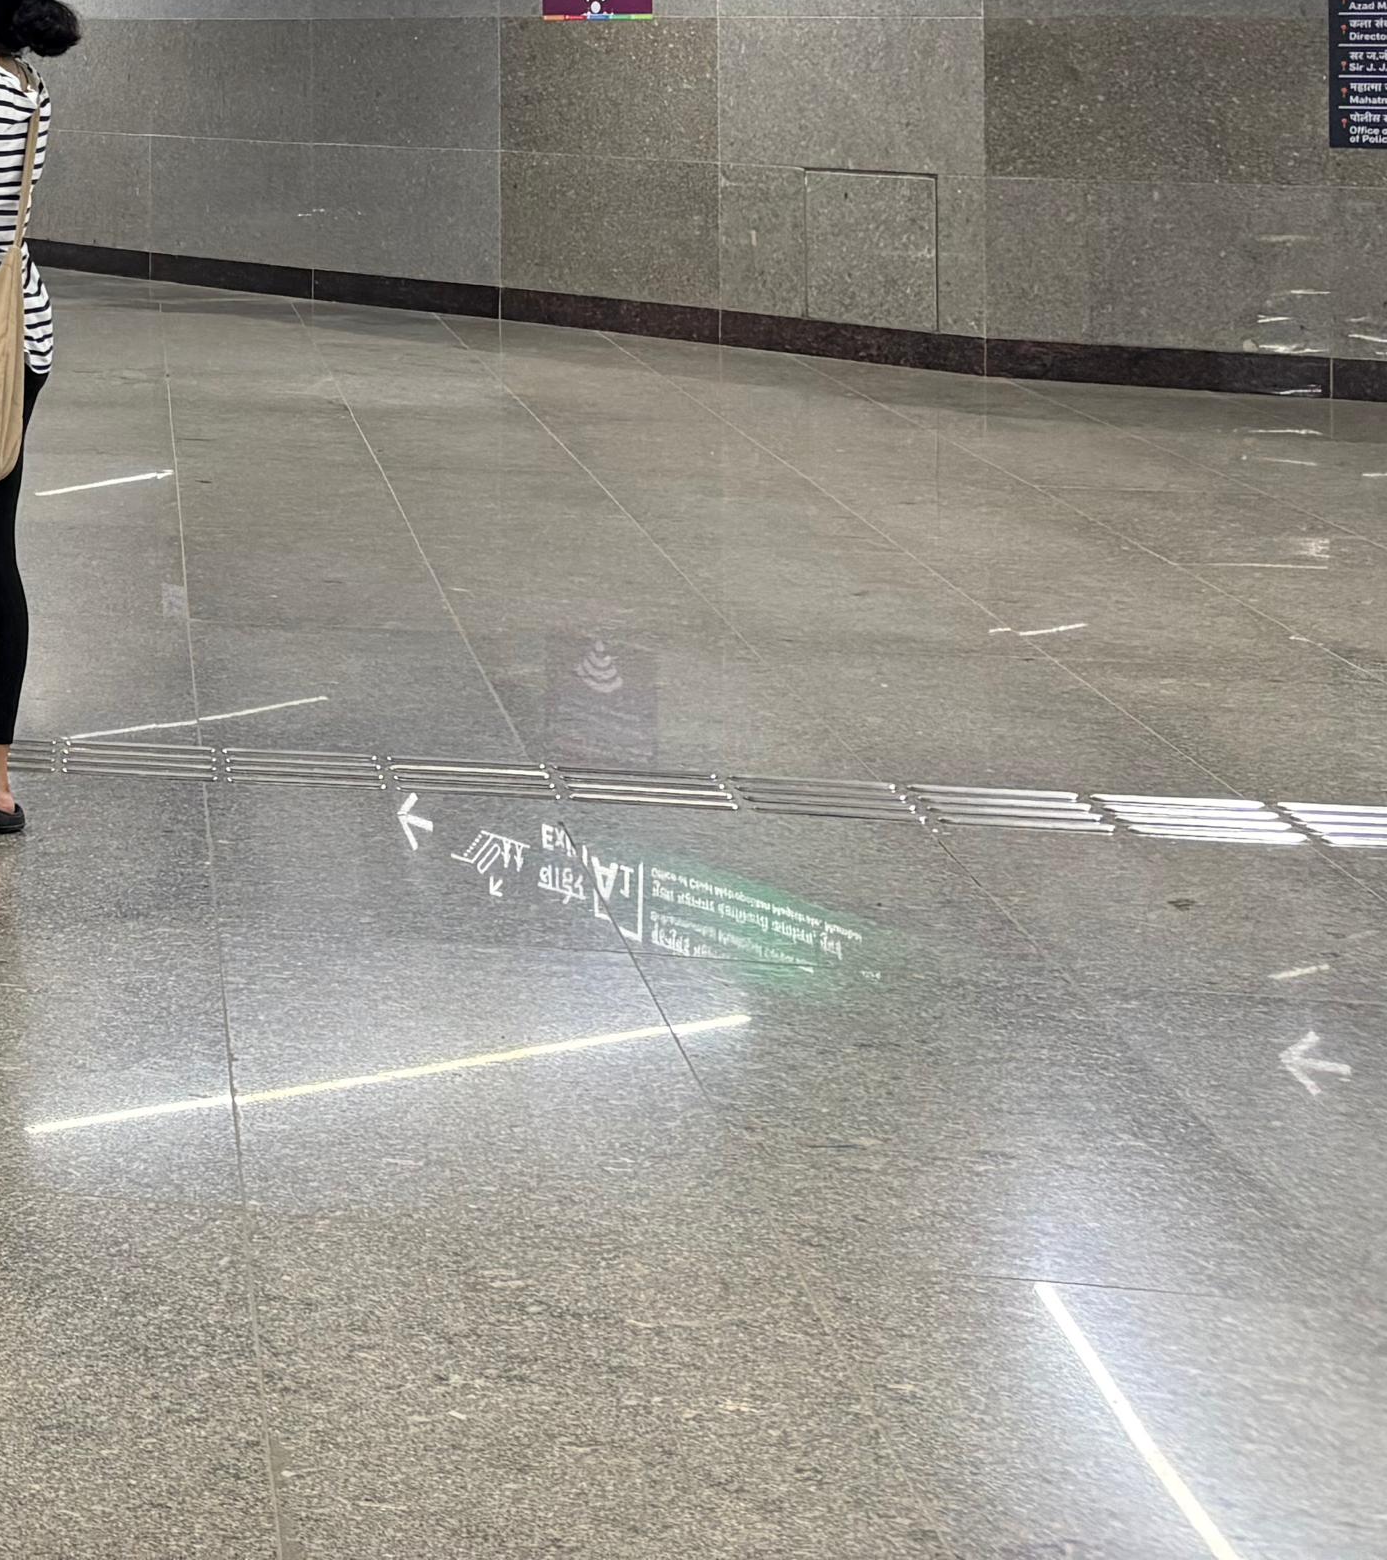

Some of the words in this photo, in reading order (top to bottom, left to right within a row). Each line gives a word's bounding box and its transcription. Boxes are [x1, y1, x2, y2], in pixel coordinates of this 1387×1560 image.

[1349, 1, 1375, 10] Azad
[1349, 31, 1387, 41] Directo
[1349, 62, 1365, 72] Sir
[1349, 125, 1380, 135] Office
[1362, 135, 1387, 144] Polic
